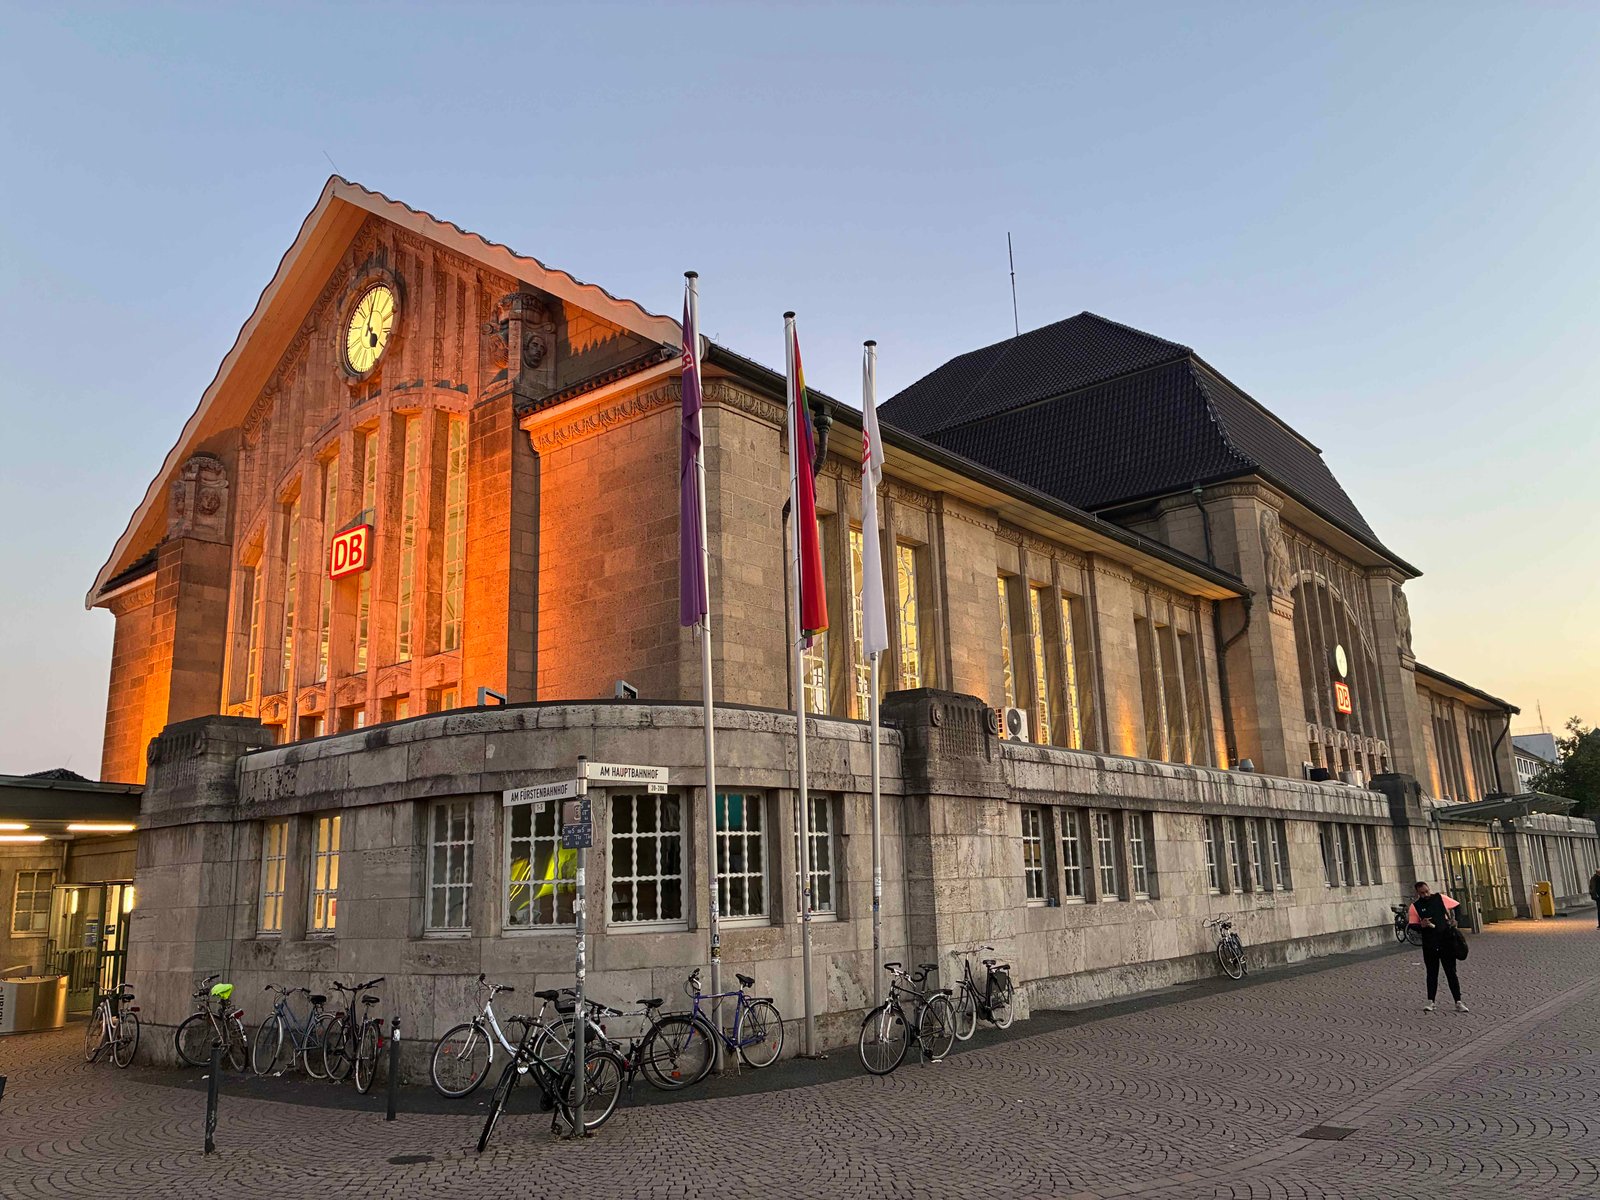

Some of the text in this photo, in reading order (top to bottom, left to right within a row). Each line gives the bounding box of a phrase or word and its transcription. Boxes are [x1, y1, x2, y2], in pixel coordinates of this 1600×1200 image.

[333, 533, 363, 572] DB
[1337, 686, 1350, 708] DB
[600, 766, 659, 779] AM HAUPTBAHNHOF
[510, 783, 568, 802] AM FÜRSTENBAHNHOF
